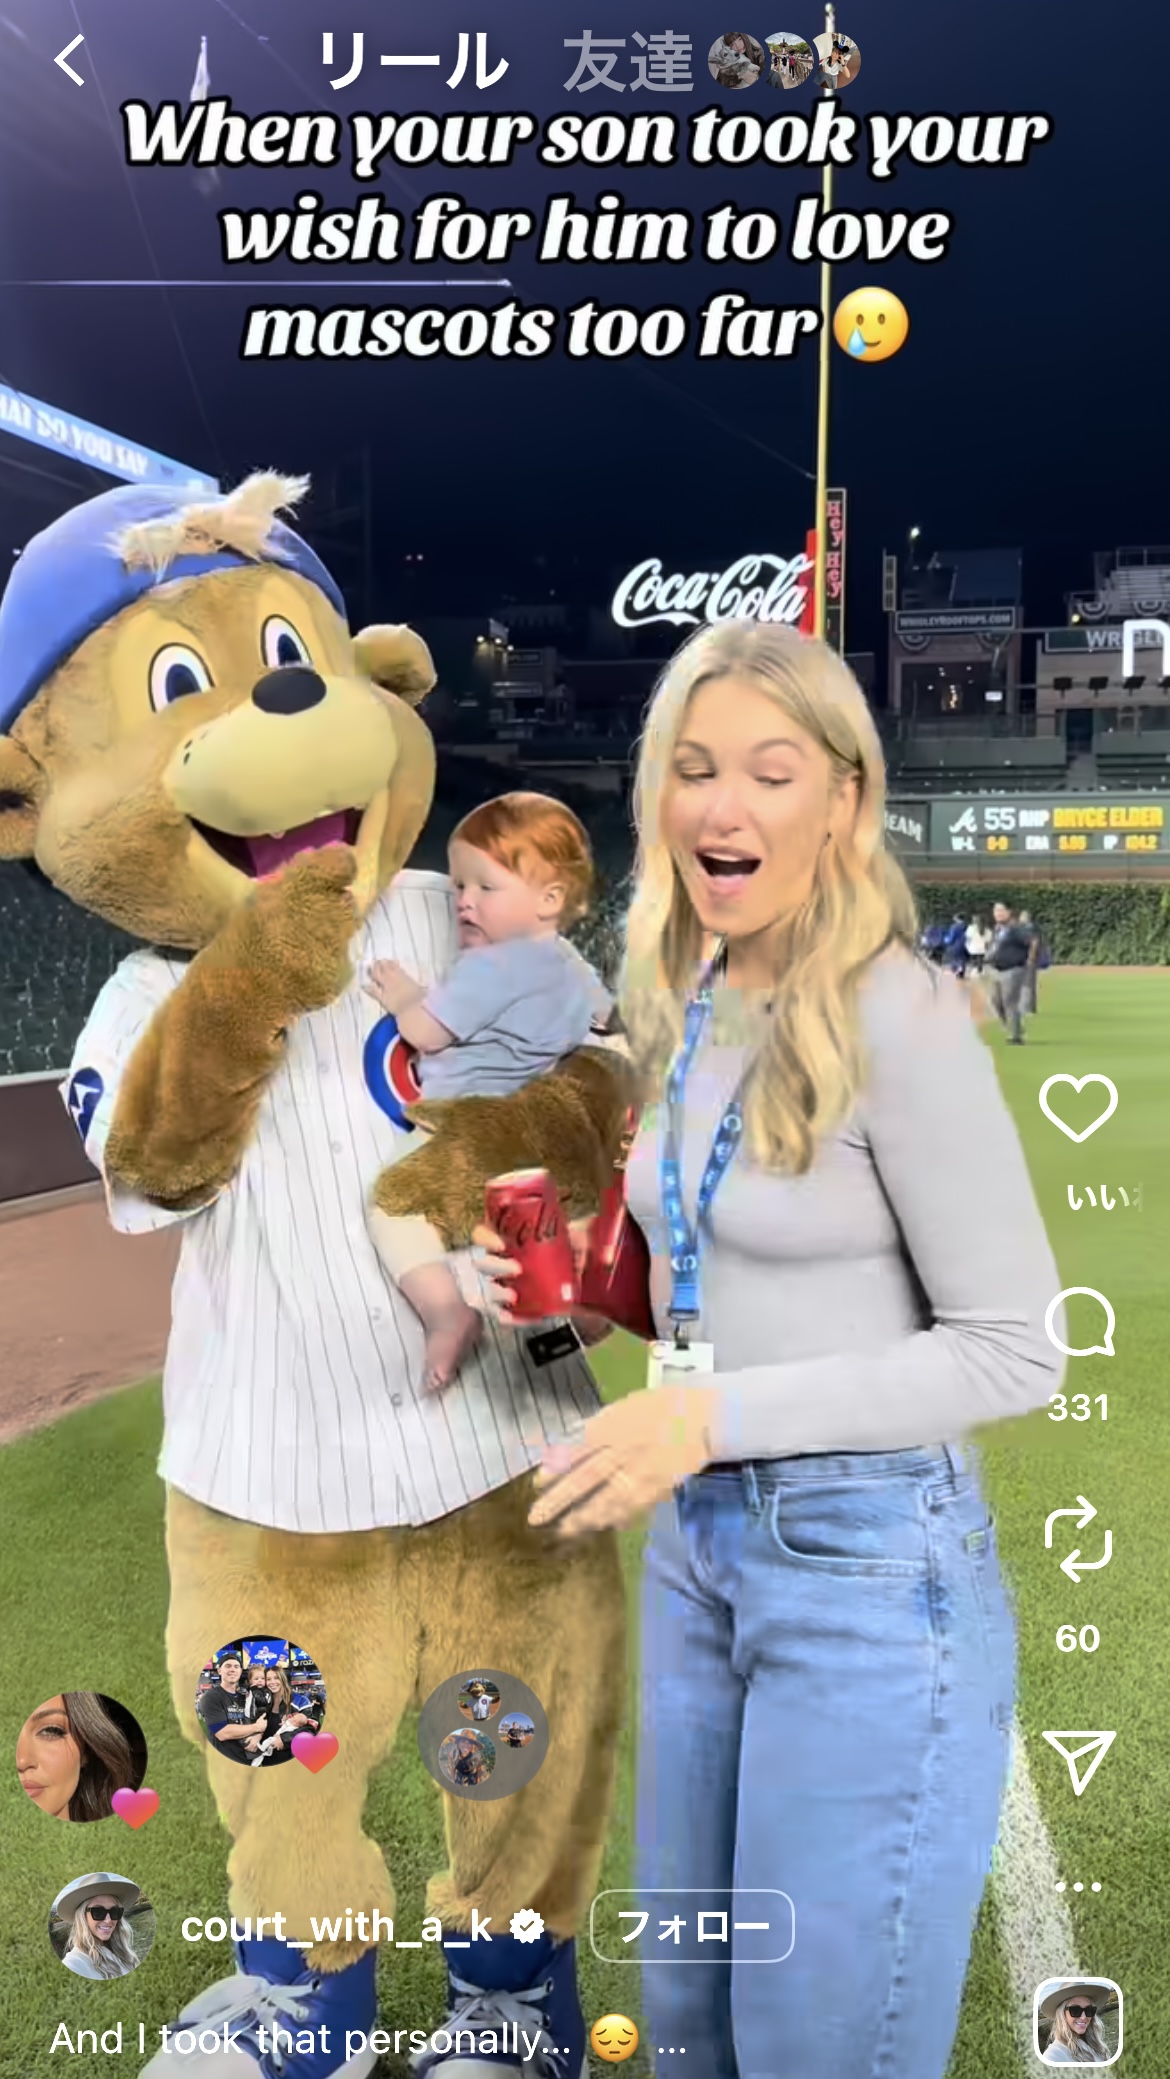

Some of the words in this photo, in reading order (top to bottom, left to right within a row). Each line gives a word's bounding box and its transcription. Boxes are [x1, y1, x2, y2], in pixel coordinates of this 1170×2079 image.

[37, 410, 68, 443] DO
[71, 423, 113, 464] YOU
[115, 444, 149, 476] SAY
[825, 501, 843, 546] Hey
[825, 552, 842, 597] Hey
[984, 807, 1016, 830] 55
[1053, 807, 1107, 829] BRYCE
[1109, 807, 1163, 829] ELDER
